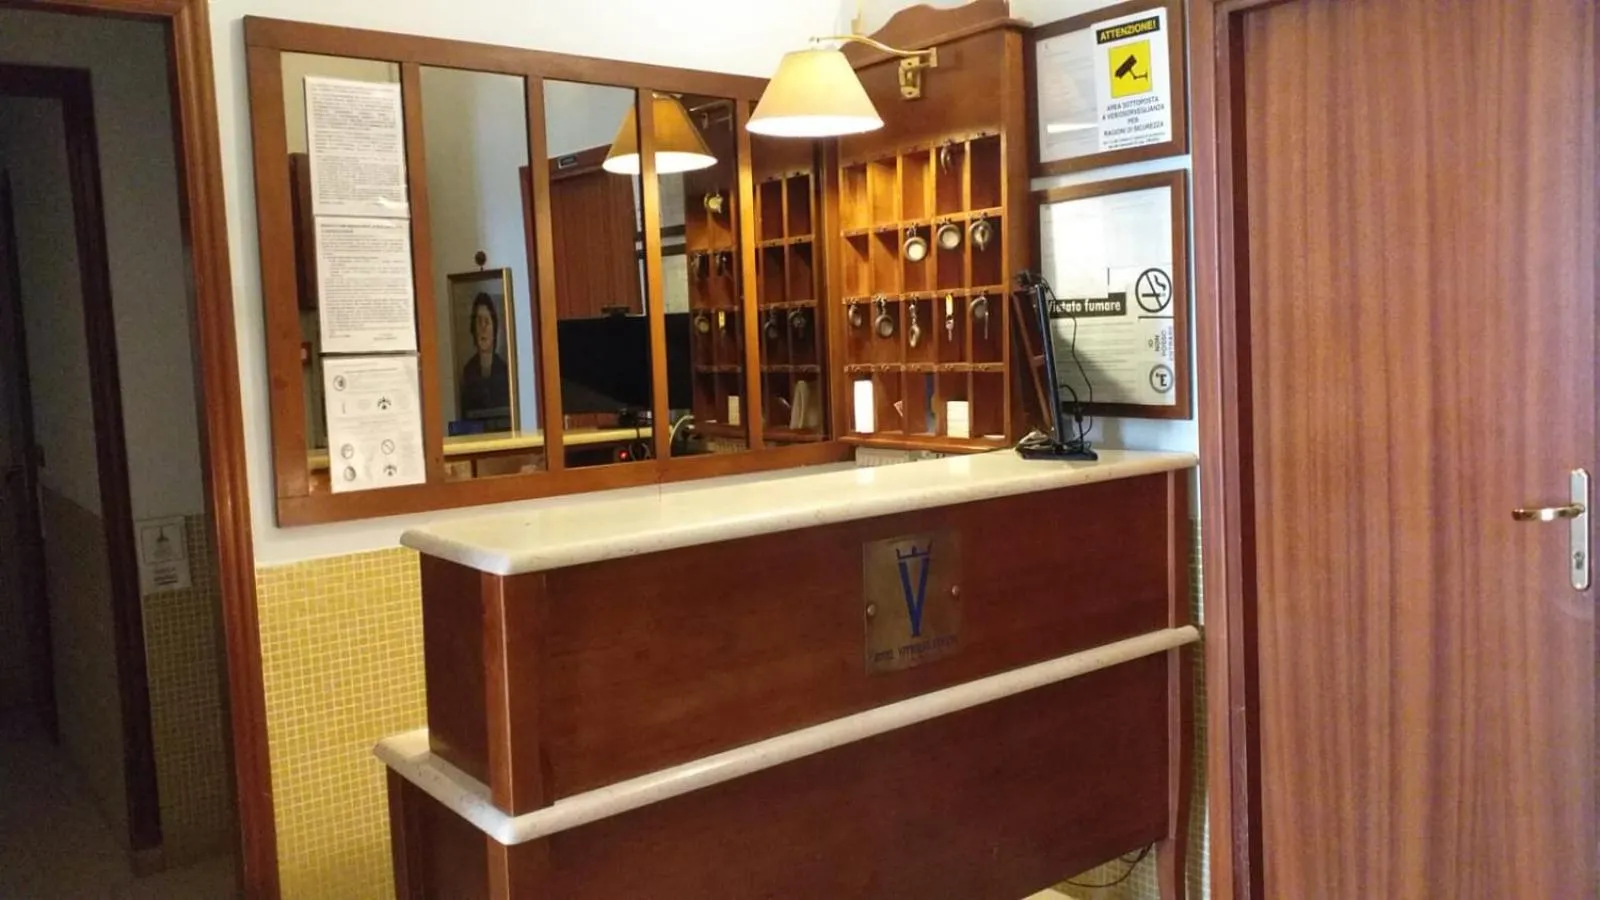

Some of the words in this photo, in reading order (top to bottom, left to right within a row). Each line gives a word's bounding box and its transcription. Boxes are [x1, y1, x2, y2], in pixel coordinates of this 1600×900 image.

[1100, 19, 1157, 41] ATTENZIONE!
[1107, 102, 1122, 111] AREA
[1123, 96, 1159, 109] SOTTOPOSTA
[1134, 121, 1164, 132] SICUREZZA
[1048, 300, 1082, 313] Vietato
[1084, 298, 1121, 312] fumare
